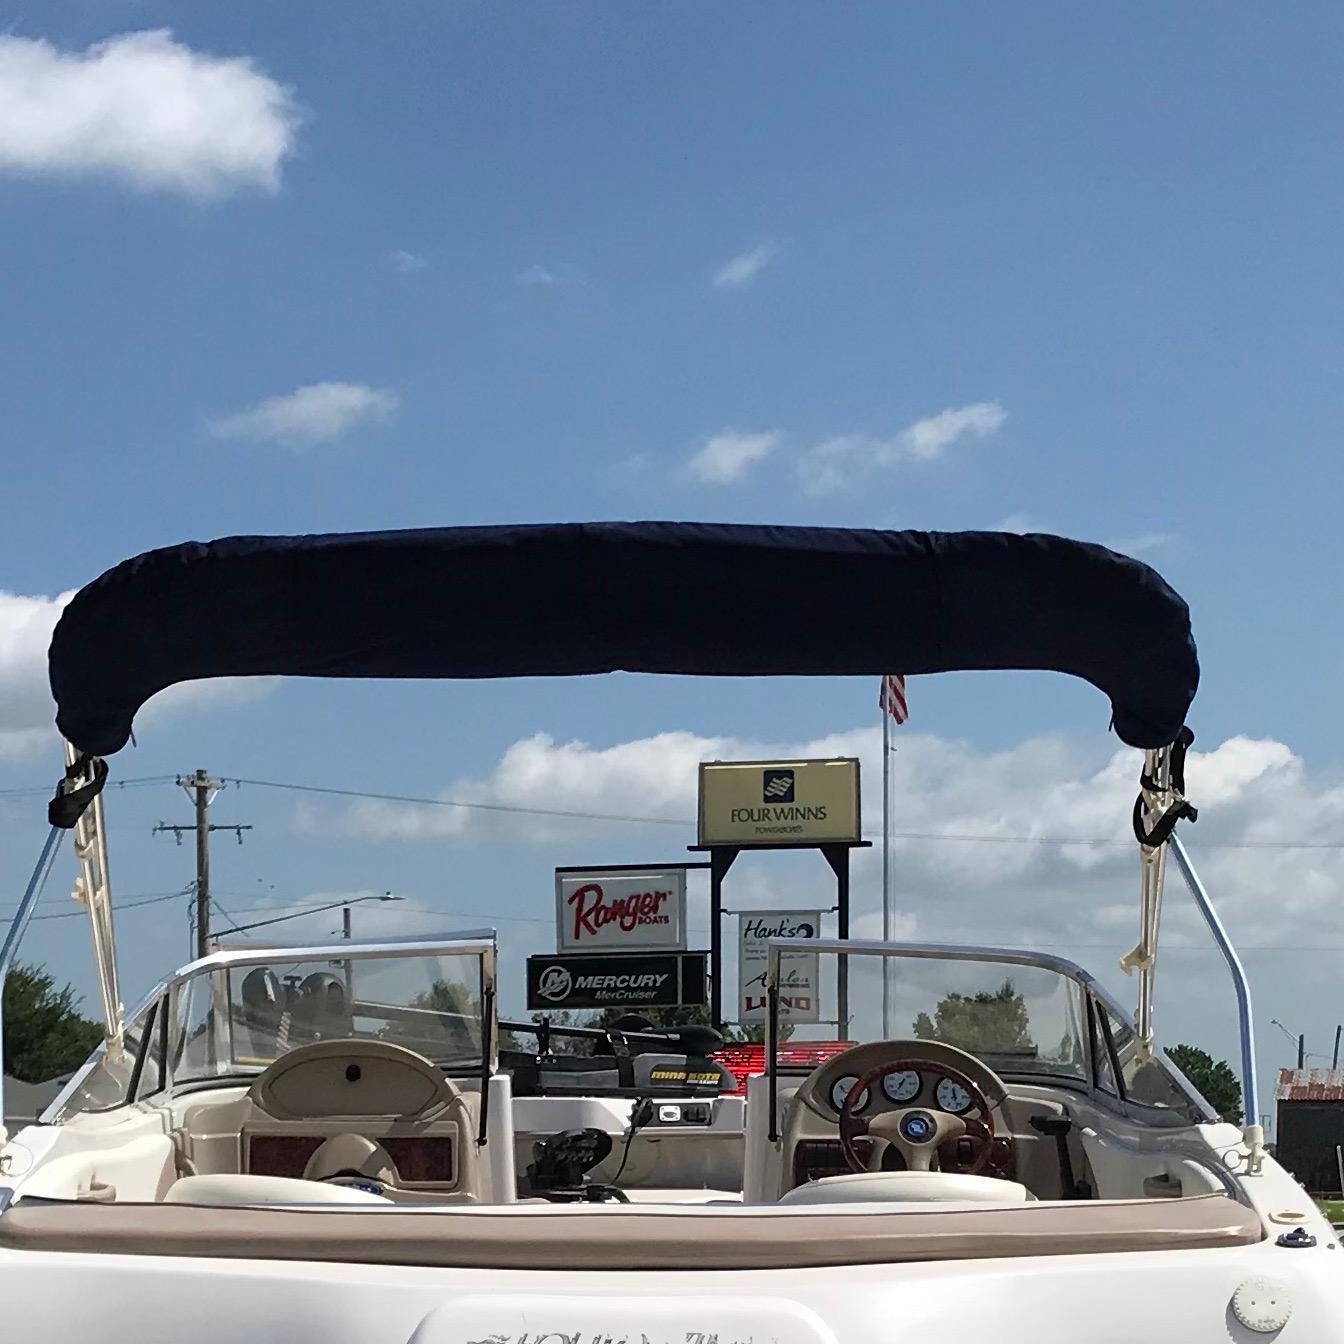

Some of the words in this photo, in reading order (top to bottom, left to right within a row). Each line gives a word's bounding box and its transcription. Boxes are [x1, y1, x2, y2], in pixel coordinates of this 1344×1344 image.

[731, 808, 772, 823] FOUR
[773, 806, 827, 821] WINNS
[567, 883, 668, 940] Ranger
[637, 914, 670, 926] BOATS
[744, 918, 797, 939] Hank's
[575, 974, 669, 989] MERCURY
